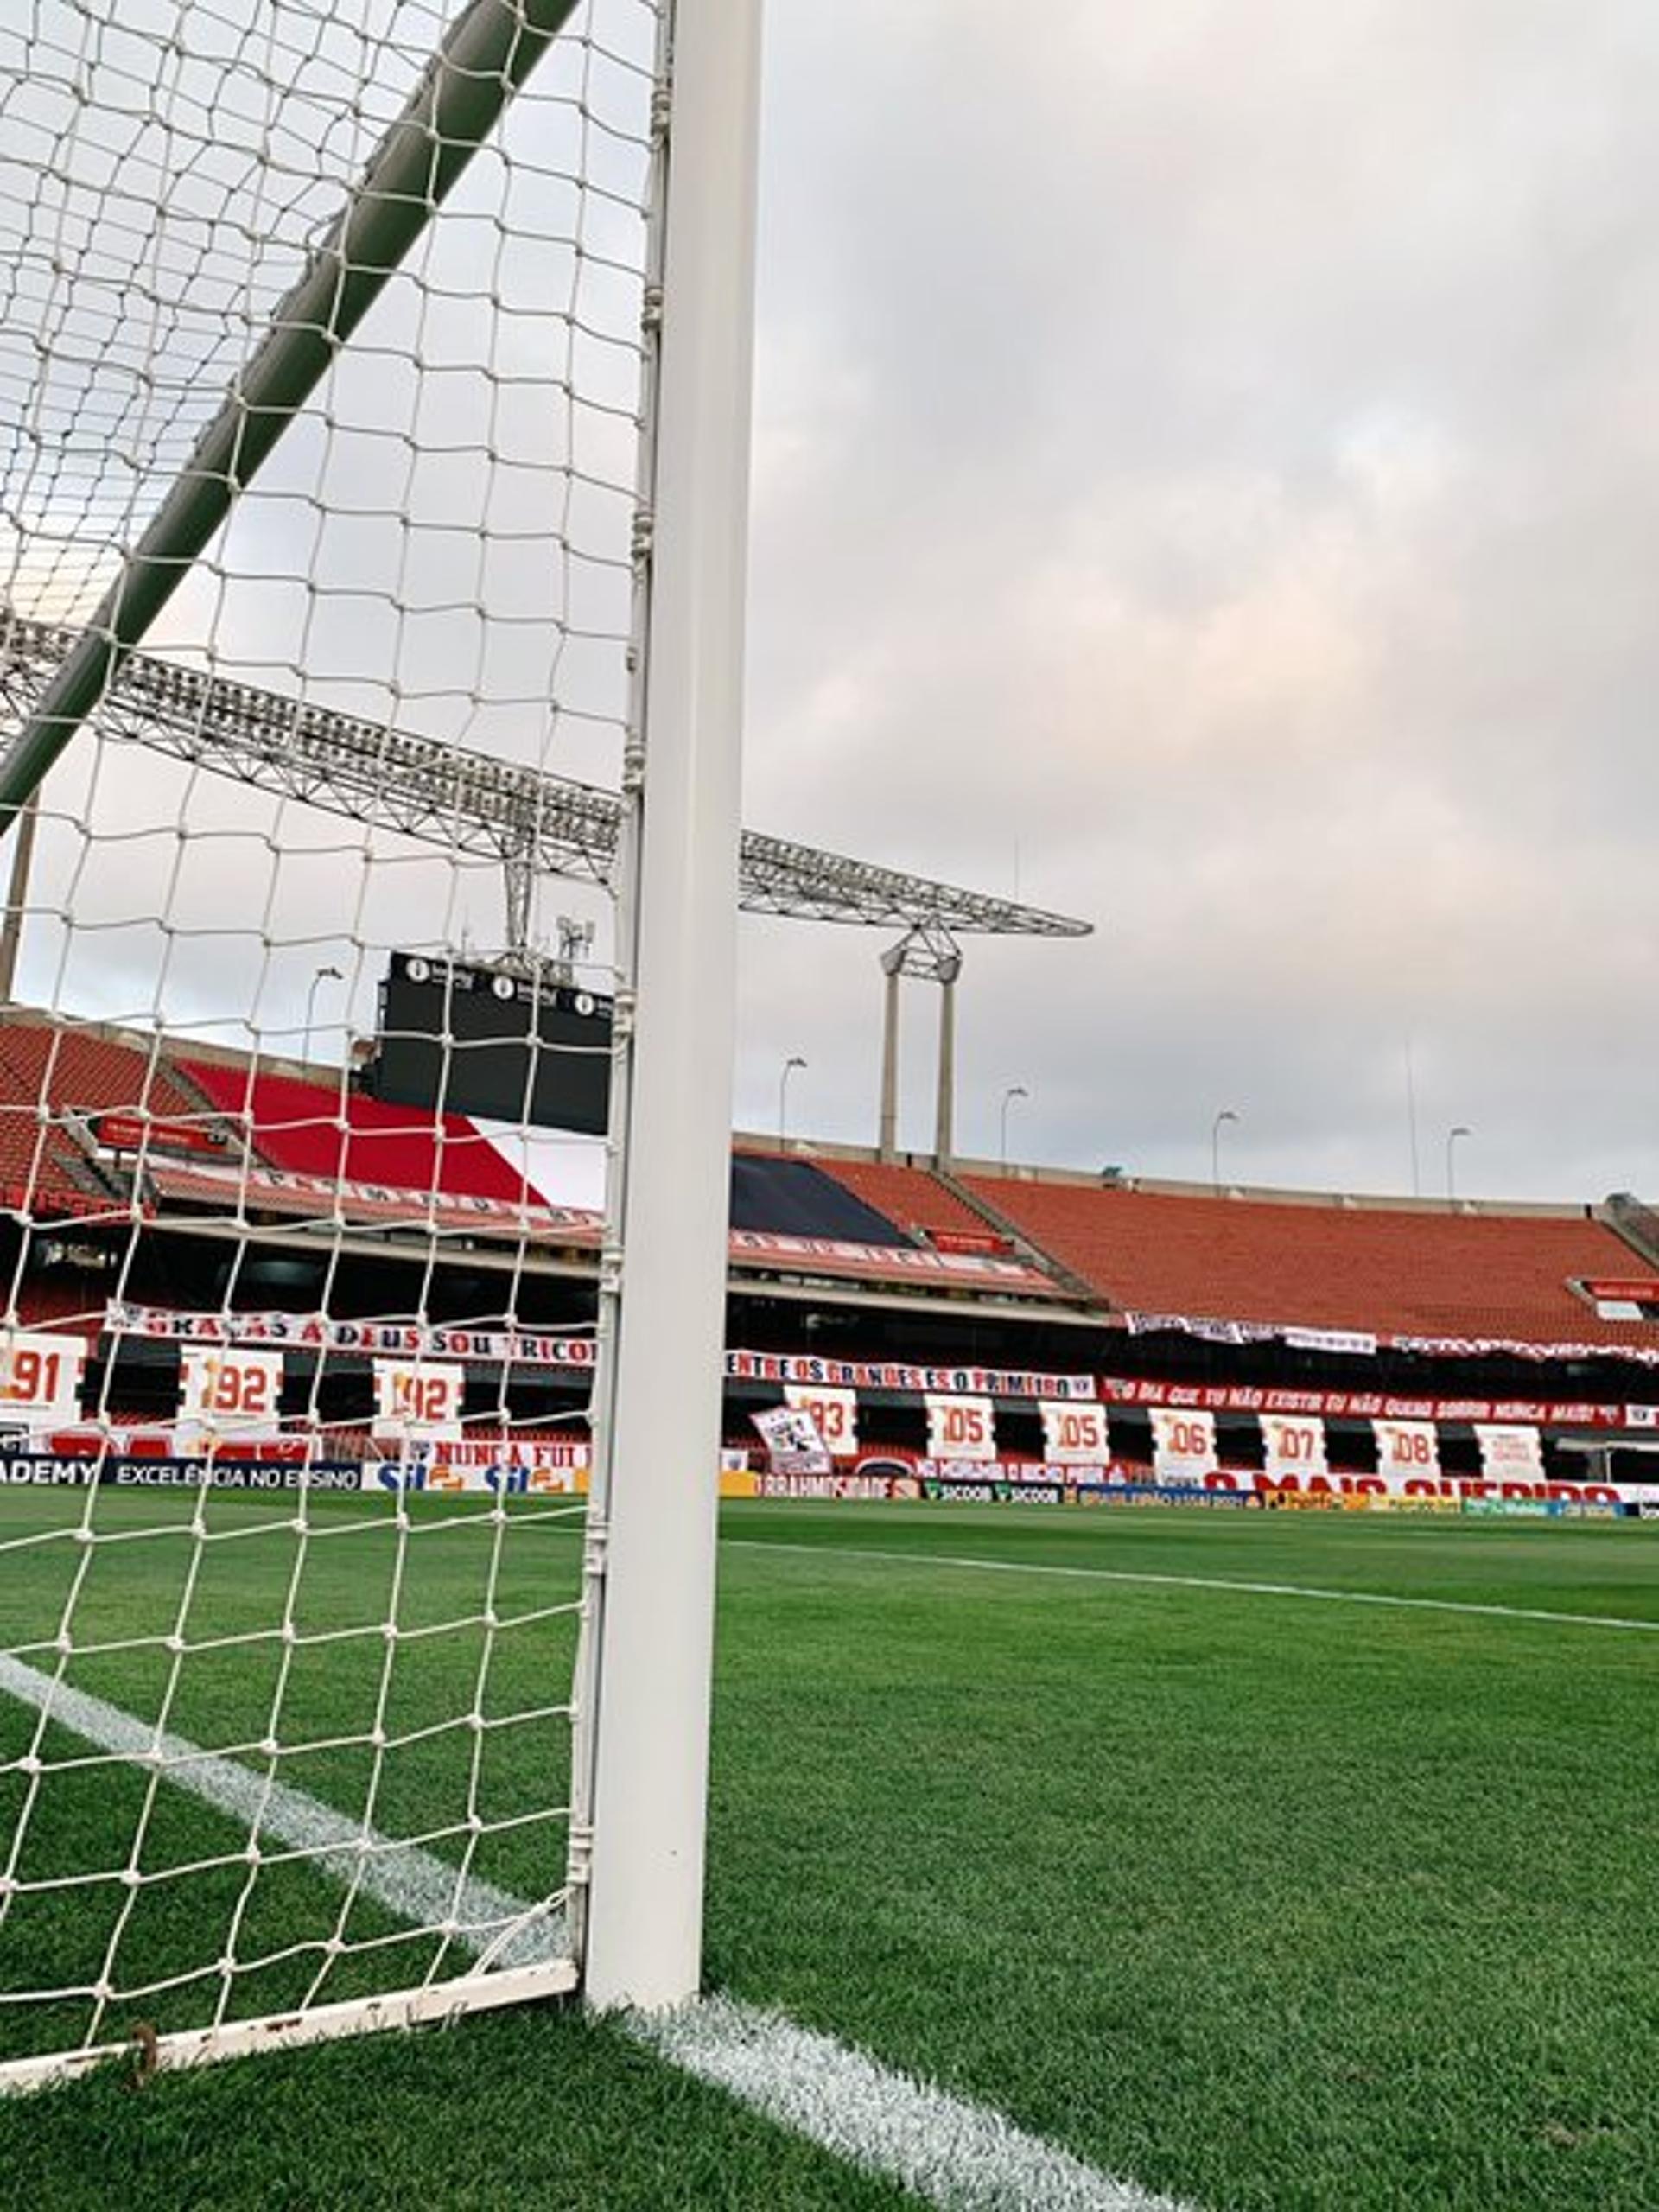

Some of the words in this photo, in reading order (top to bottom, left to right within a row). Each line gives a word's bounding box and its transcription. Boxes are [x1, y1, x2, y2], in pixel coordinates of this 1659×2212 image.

[336, 1328, 420, 1350] DEUS
[432, 1330, 492, 1354] SOU
[116, 1464, 245, 1488] EXCELÊNCIA
[250, 1469, 280, 1488] NO
[285, 1469, 358, 1490] ENSINO
